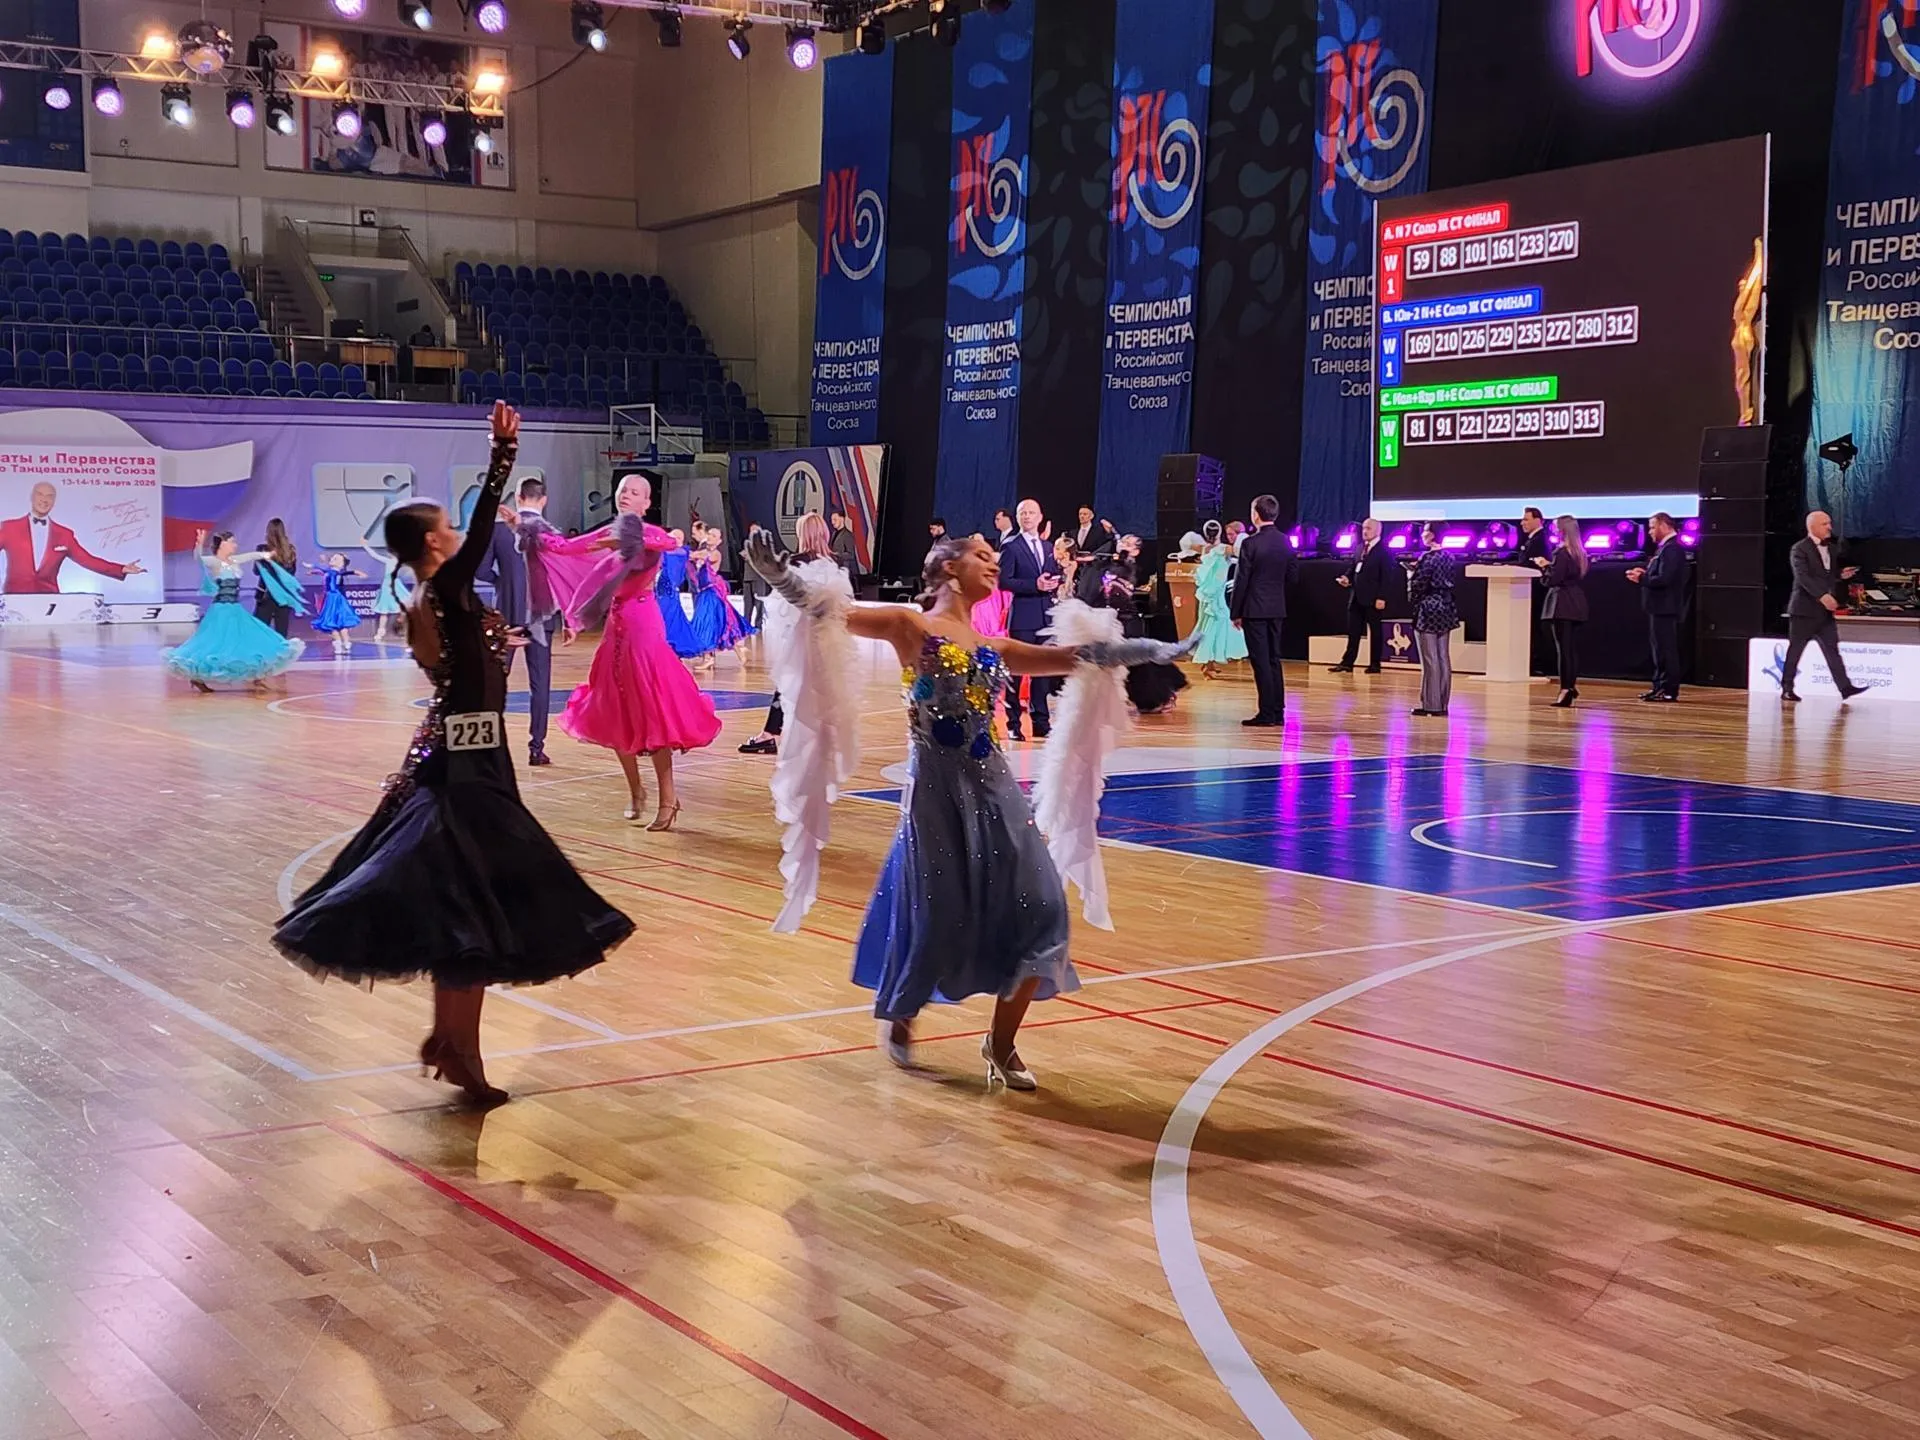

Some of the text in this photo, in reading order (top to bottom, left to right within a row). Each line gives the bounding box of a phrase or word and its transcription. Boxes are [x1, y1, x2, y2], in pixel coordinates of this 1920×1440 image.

[1836, 197, 1920, 228] ЧЕМПИ
[1412, 222, 1437, 236] Соло
[1438, 218, 1449, 232] Ж
[1450, 216, 1464, 230] СТ
[1464, 210, 1500, 228] ФИНАЛ
[1413, 229, 1574, 271] 59 88 101 161 233 270
[1826, 247, 1841, 266] и
[1384, 255, 1398, 272] W
[1387, 278, 1395, 295] 1
[1443, 304, 1467, 317] Соло
[1468, 301, 1479, 314] Ж
[1481, 299, 1494, 313] СТ
[1495, 294, 1533, 310] ФИНАЛ
[1310, 315, 1320, 331] и
[1410, 314, 1633, 355] 169 210 226 229 235 272 280 312
[814, 336, 880, 357] ЧЕМПИОНАТЫ
[1383, 337, 1396, 354] W
[819, 359, 880, 379] ПЕРВЕНСТВА
[1311, 357, 1371, 375] Танцева
[1386, 361, 1393, 377] 1
[1105, 371, 1192, 390] Танцевальноо
[1458, 387, 1483, 401] Соло
[1484, 386, 1495, 399] Ж
[1496, 384, 1510, 397] СТ
[1511, 381, 1549, 396] ФИНАЛ
[1129, 394, 1168, 409] Союза
[1382, 421, 1396, 436] W
[1410, 408, 1600, 437] 81 91 221 223 293 310 313
[39, 455, 49, 464] и
[55, 452, 156, 467] Первенства
[1385, 444, 1392, 460] 1
[11, 464, 110, 475] Танцевального
[114, 466, 156, 475] Союза
[62, 478, 101, 486] 13-14-15
[103, 480, 132, 488] марта
[45, 603, 57, 616] 1
[142, 607, 162, 619] 3
[1866, 665, 1893, 676] ЗАВОД
[453, 720, 494, 746] 223
